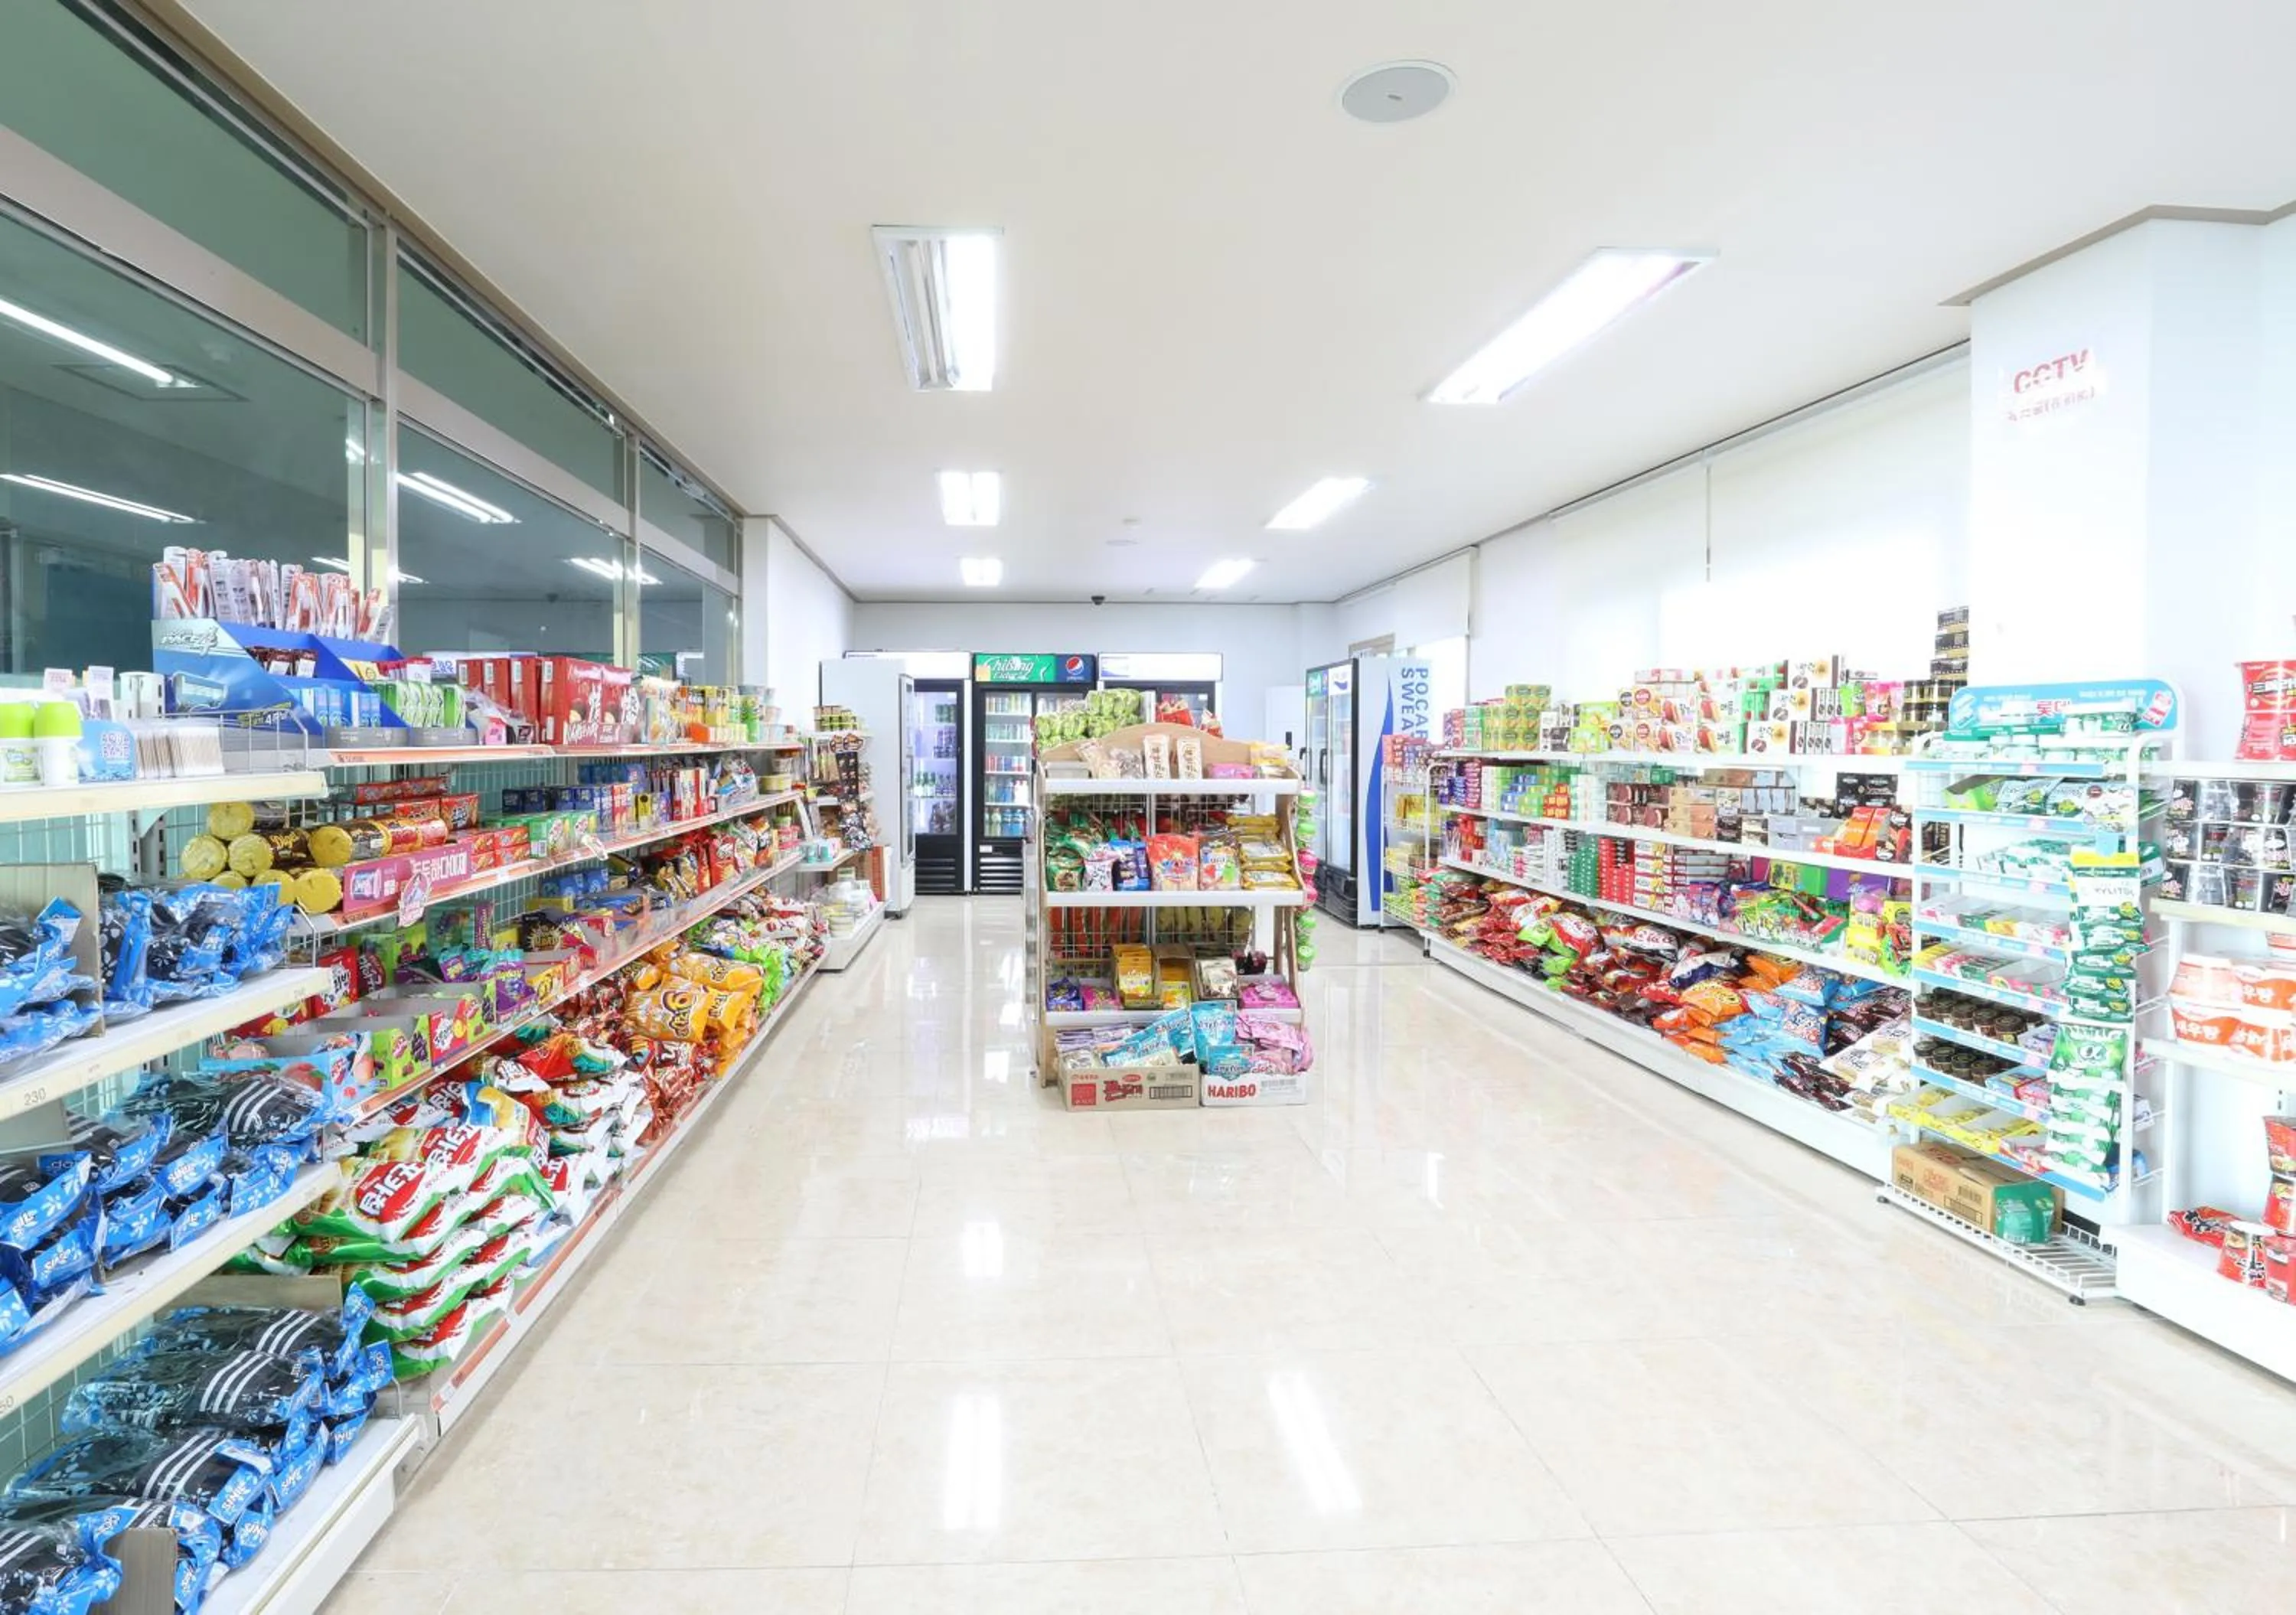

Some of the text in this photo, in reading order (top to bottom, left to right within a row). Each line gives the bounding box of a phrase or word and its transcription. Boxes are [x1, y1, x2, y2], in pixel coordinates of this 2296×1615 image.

[2014, 348, 2089, 394] CCTV
[1401, 666, 1415, 739] SWEA
[24, 1087, 47, 1106] 230
[1208, 1083, 1256, 1099] HARIBO
